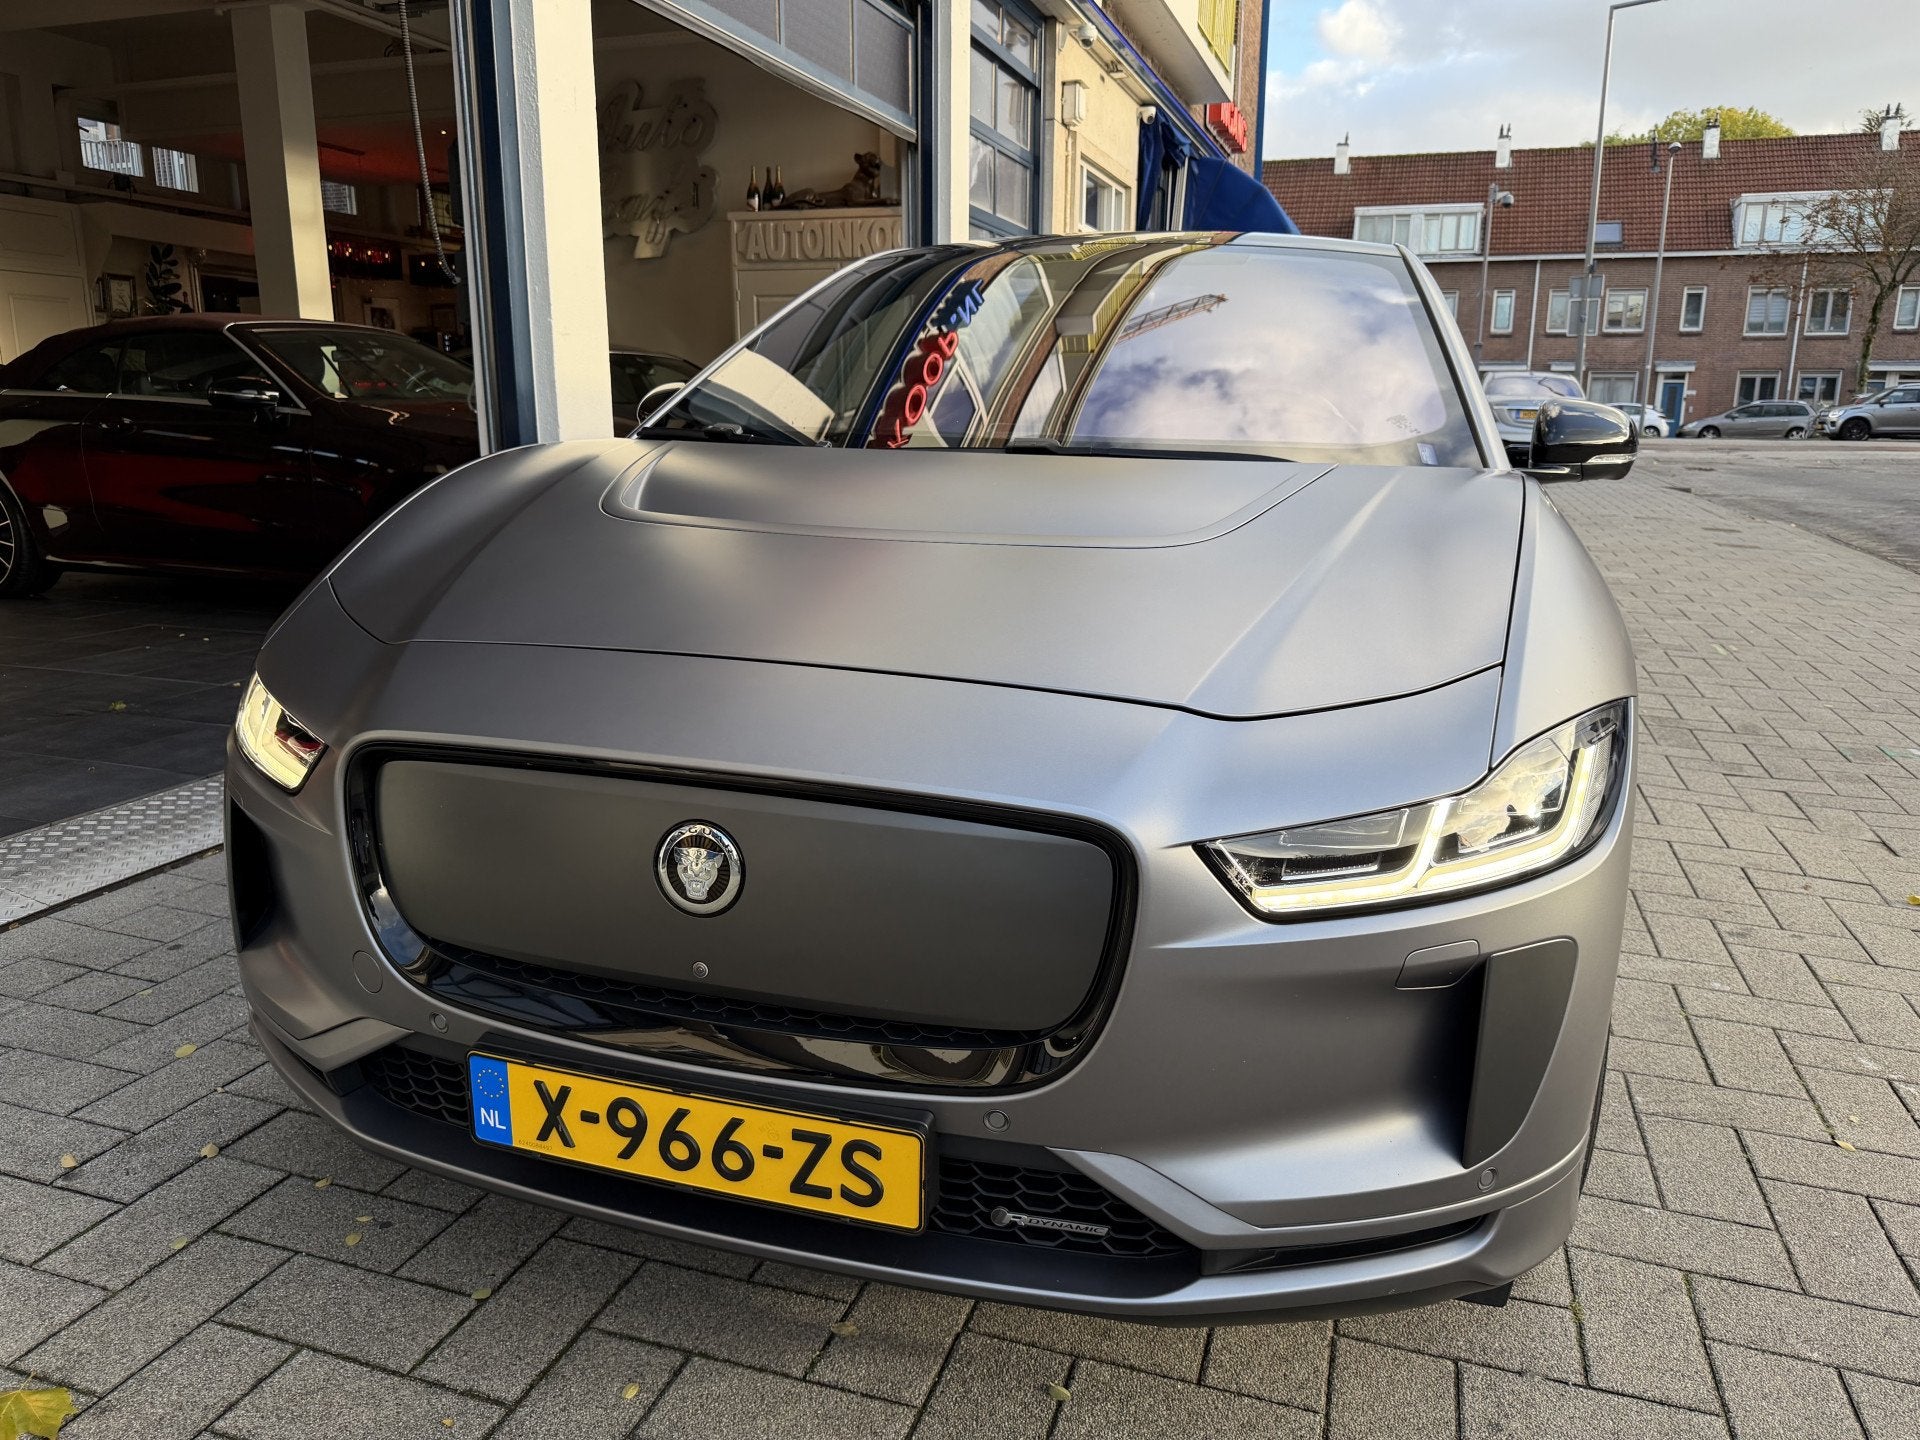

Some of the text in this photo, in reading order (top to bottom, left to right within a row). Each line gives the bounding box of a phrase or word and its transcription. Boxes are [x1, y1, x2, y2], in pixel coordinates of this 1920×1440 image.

[480, 1107, 507, 1130] NL
[534, 1080, 884, 1207] X-966-ZS
[1028, 1218, 1104, 1234] DYNAMIC
